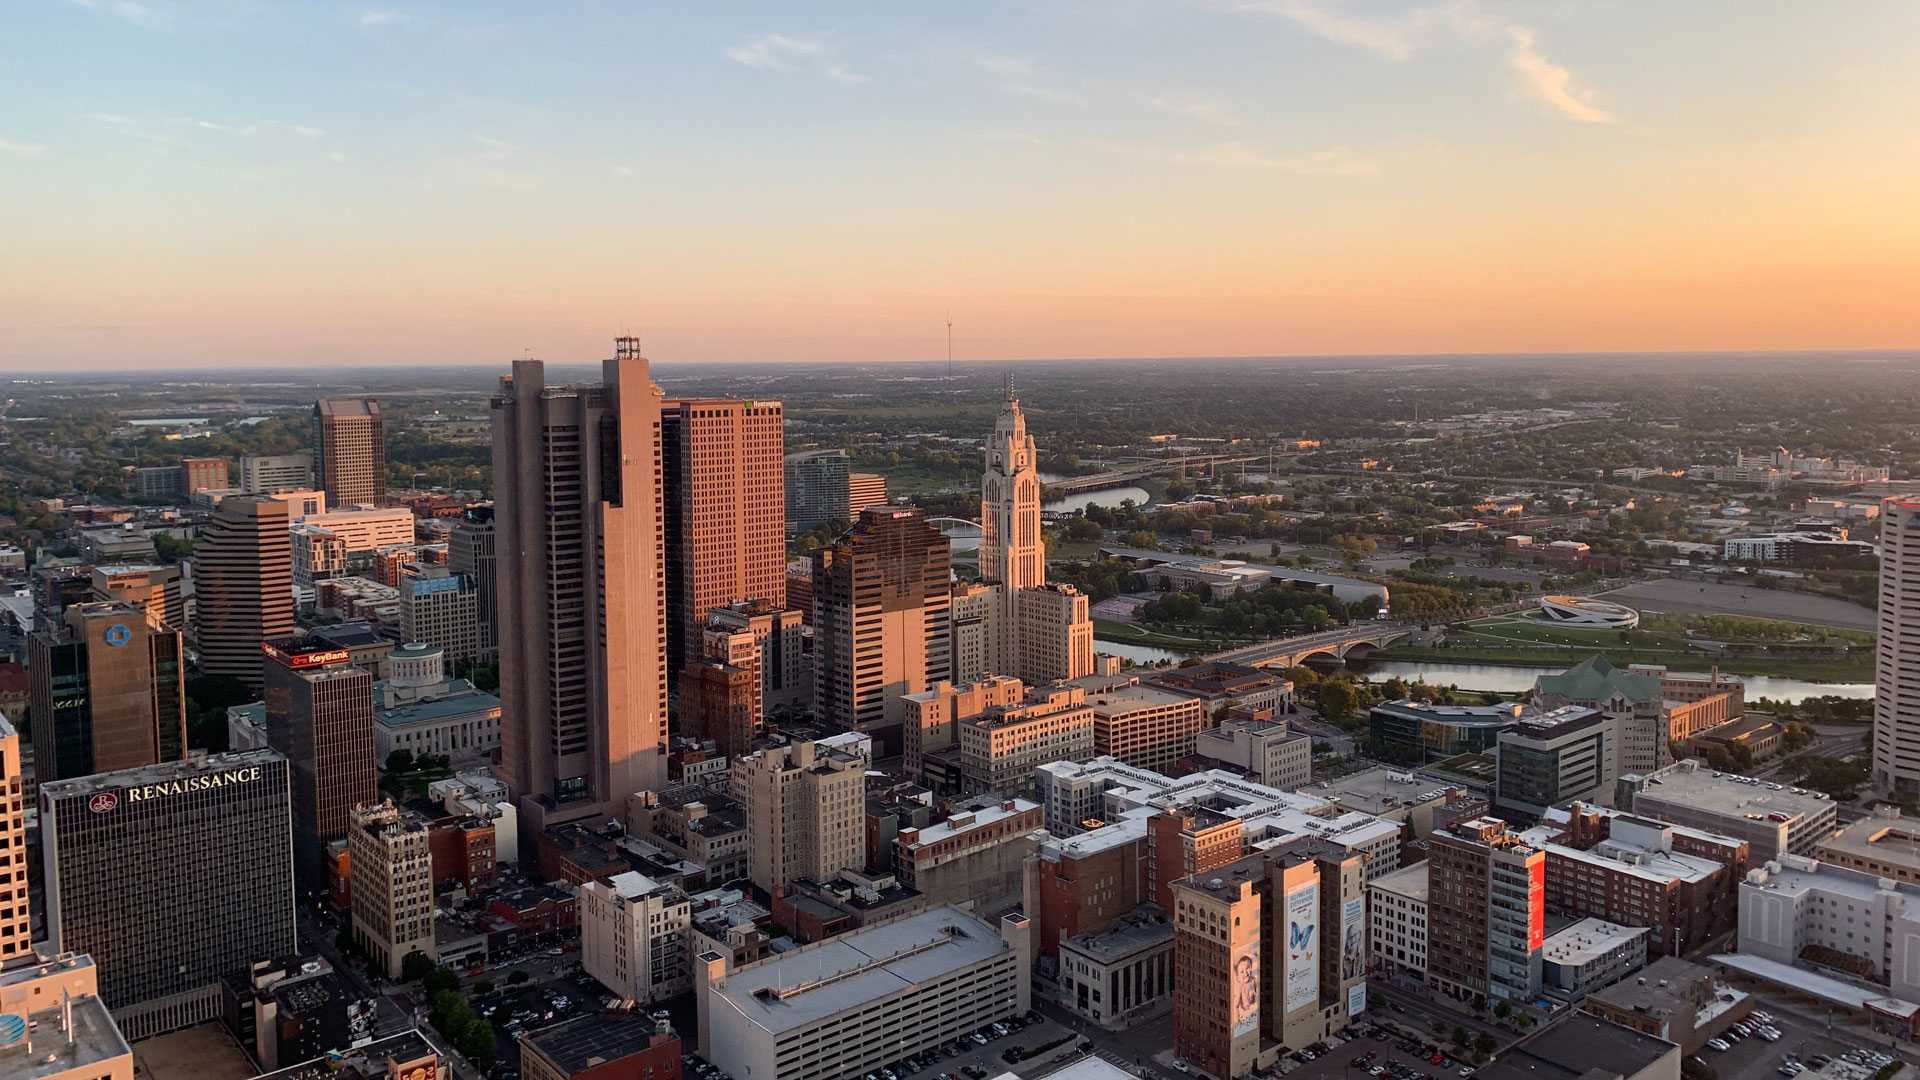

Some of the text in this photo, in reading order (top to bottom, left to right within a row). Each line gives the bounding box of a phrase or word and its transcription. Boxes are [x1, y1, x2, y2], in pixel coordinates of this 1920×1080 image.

[753, 400, 781, 409] Huntington
[308, 650, 349, 664] KeyBank
[128, 767, 261, 803] RENAISSANCE
